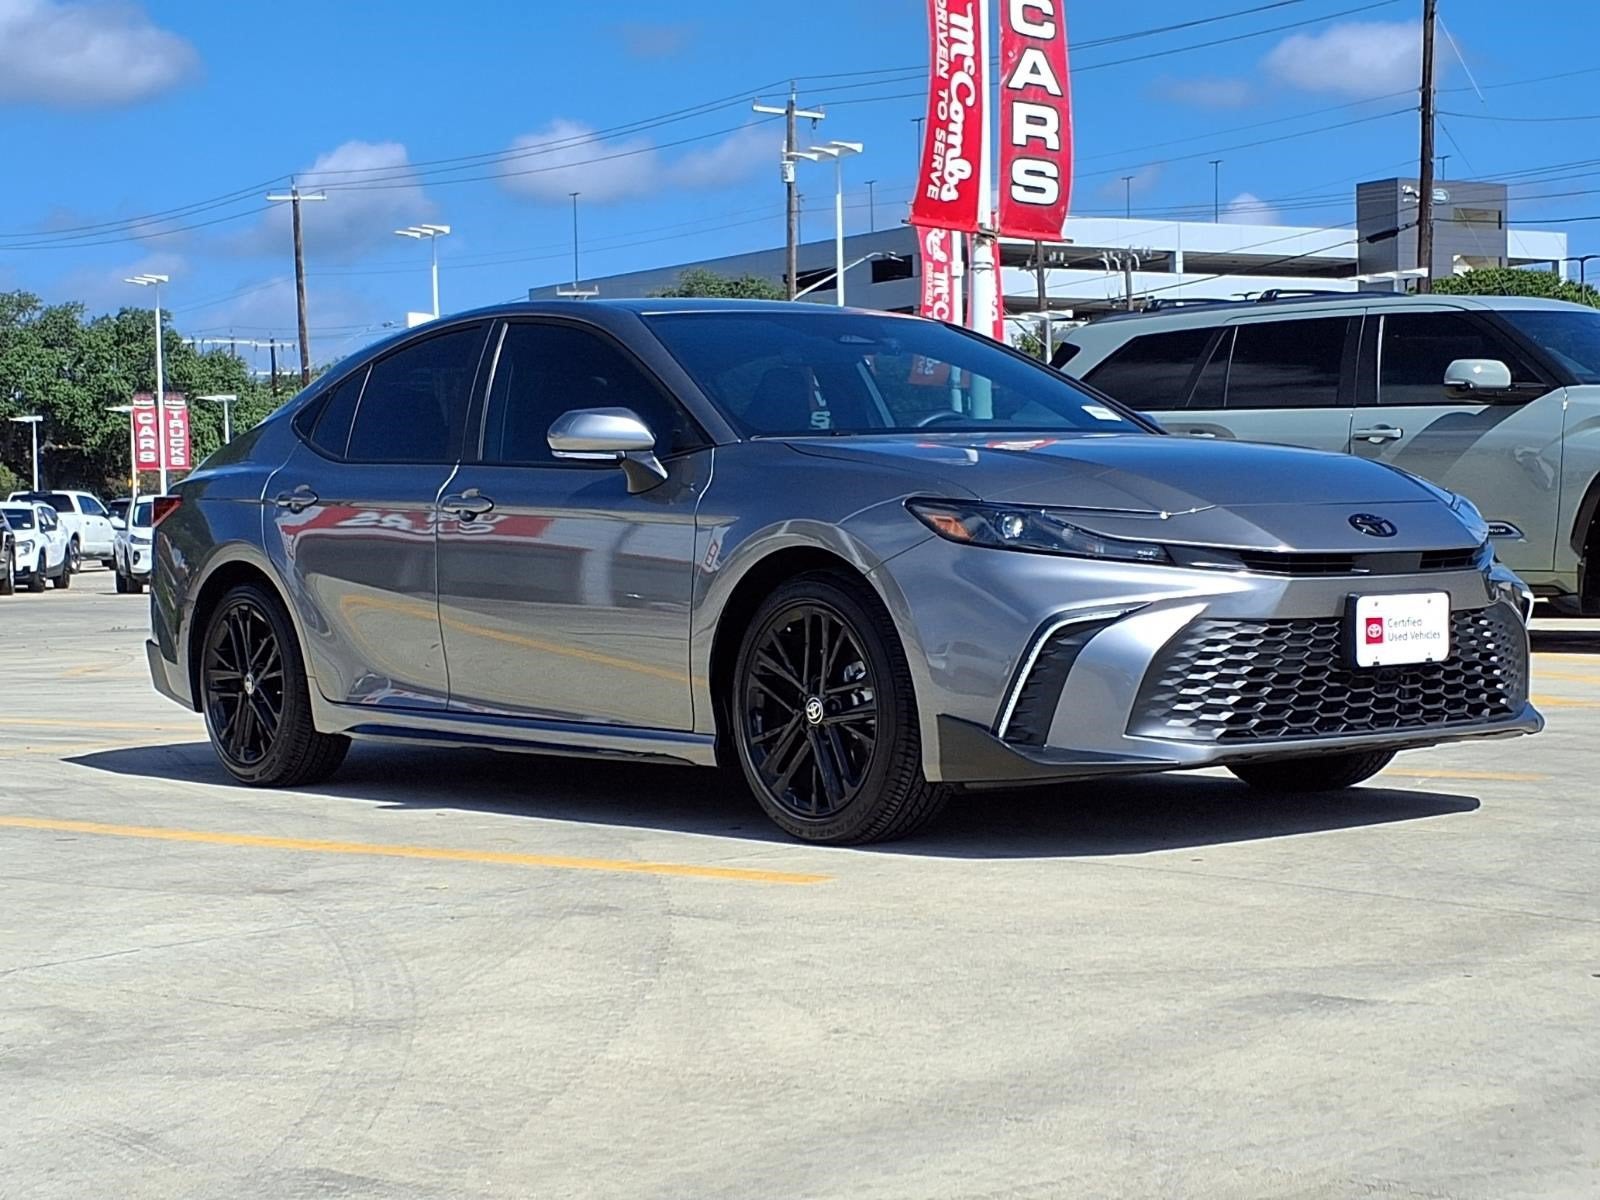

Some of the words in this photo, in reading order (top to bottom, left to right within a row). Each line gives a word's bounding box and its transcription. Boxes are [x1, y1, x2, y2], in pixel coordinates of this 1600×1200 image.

[937, 88, 949, 121] TO
[1007, 0, 1063, 206] CARS
[926, 127, 946, 200] SERVE
[137, 412, 156, 463] CARS
[168, 410, 185, 466] TRUCKS
[1387, 617, 1423, 628] Certified
[1388, 631, 1408, 641] Used
[1410, 630, 1441, 640] Vehicles
